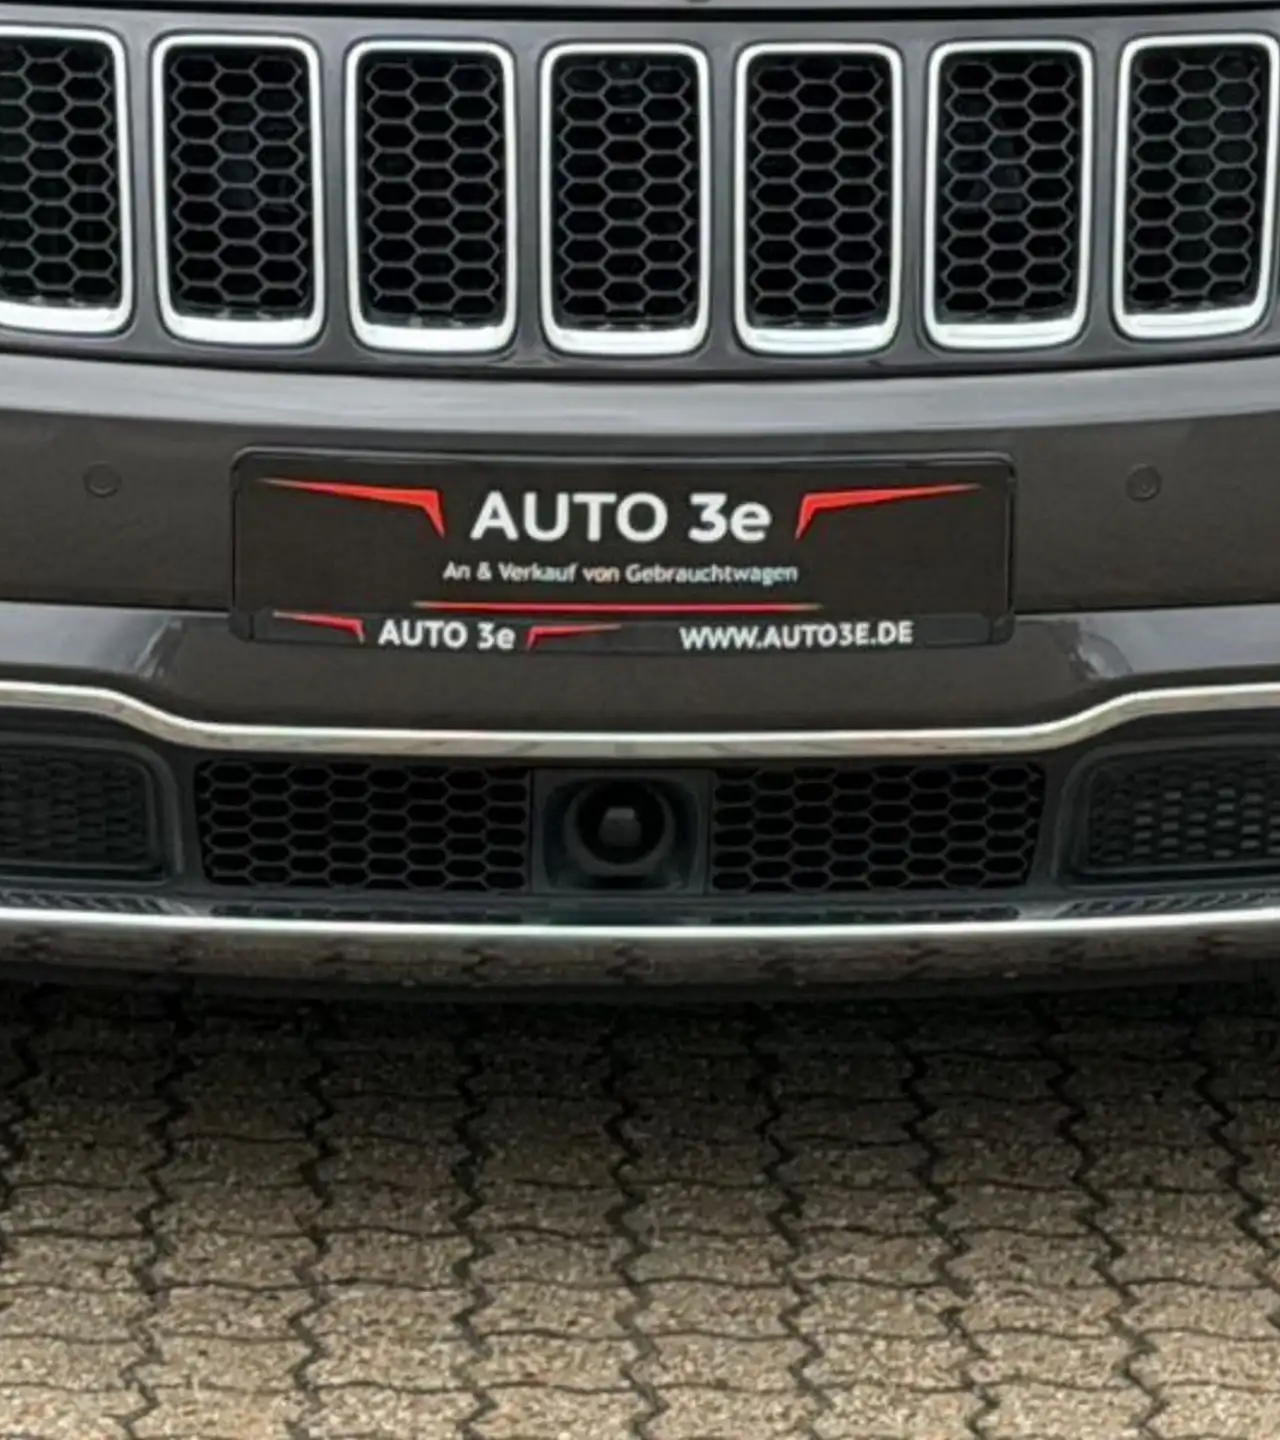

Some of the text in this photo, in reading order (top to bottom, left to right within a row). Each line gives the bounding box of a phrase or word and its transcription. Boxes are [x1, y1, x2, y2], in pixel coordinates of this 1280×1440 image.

[470, 490, 772, 543] AUTO 3e
[442, 561, 799, 586] An & Verkauf von Gebrauchtwagen
[377, 618, 516, 650] AUTO 3e
[679, 620, 915, 650] WWW.AUTO3E.DE
